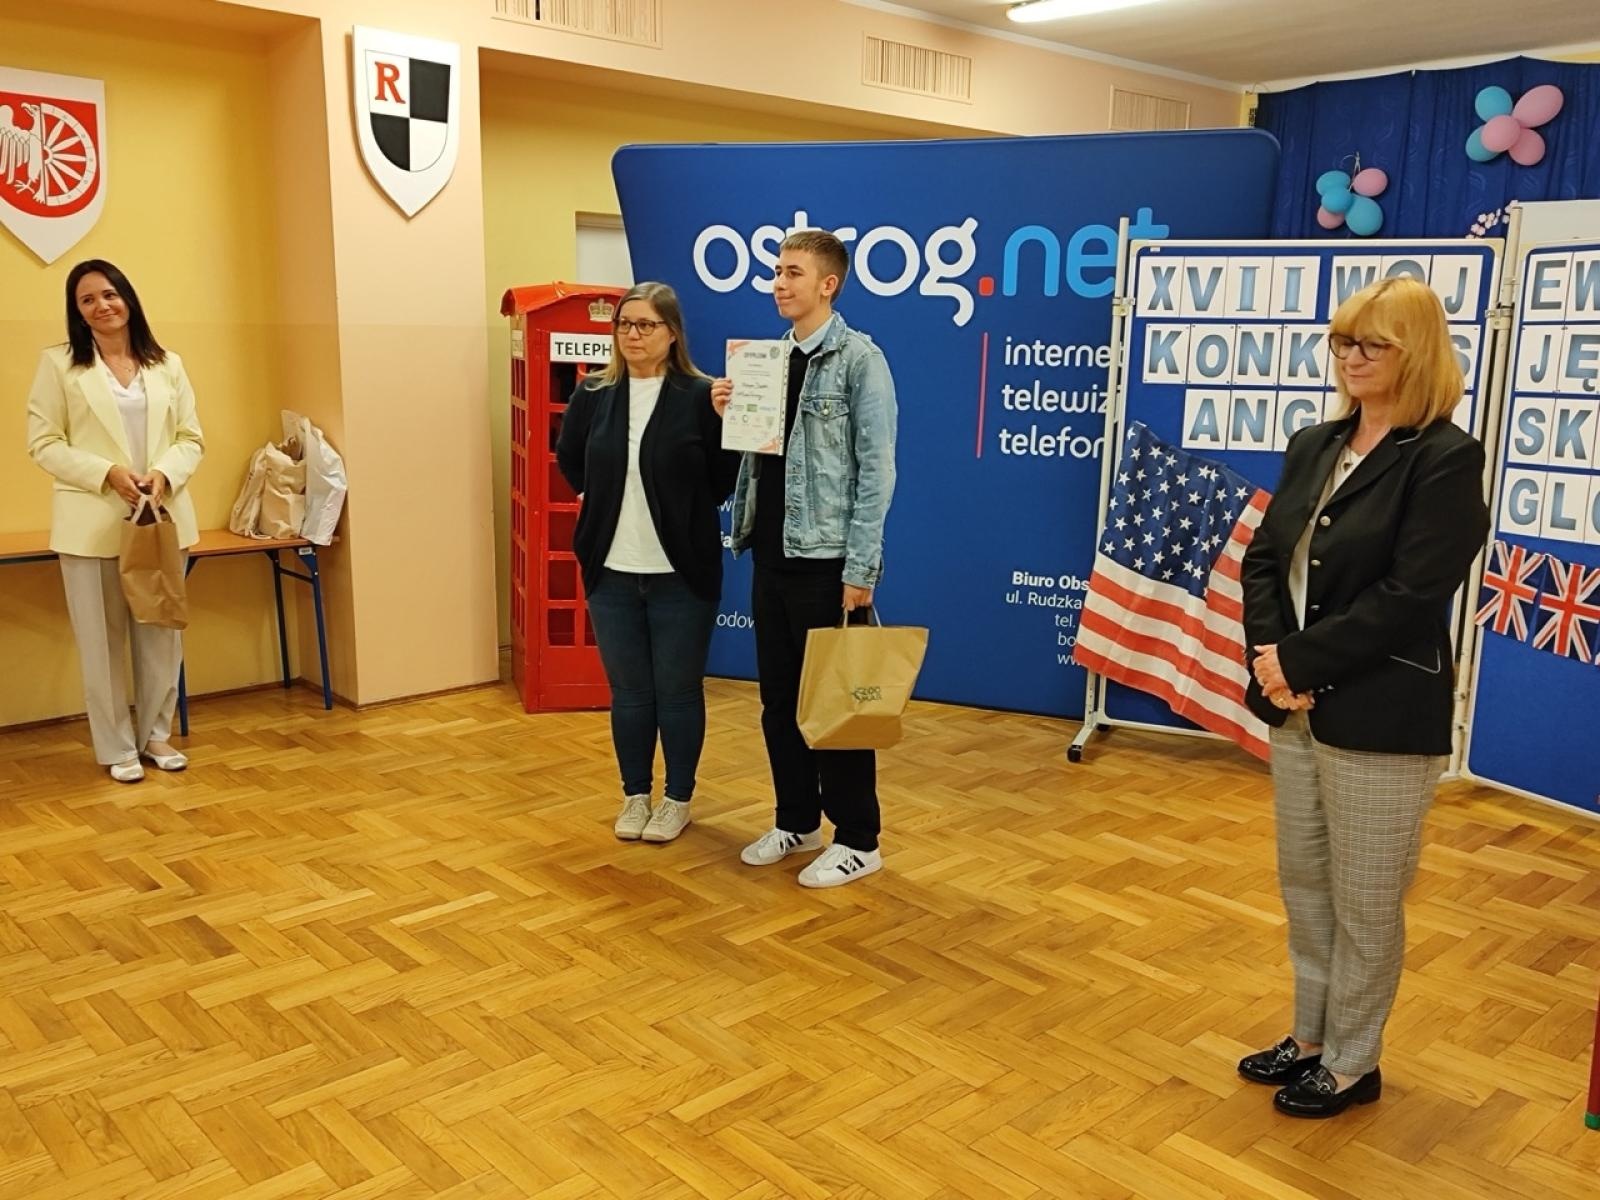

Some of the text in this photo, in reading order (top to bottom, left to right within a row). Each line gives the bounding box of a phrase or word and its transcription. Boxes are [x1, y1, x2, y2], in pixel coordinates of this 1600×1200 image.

[693, 206, 1170, 327] osog.ne
[1147, 265, 1306, 312] XVII
[554, 341, 612, 356] TELEPH
[1147, 329, 1472, 379] KONK
[1508, 477, 1600, 534] GL
[1012, 571, 1090, 591] Biuro Obs
[1005, 590, 1082, 610] ul. Rudzka
[1054, 614, 1076, 628] tel.
